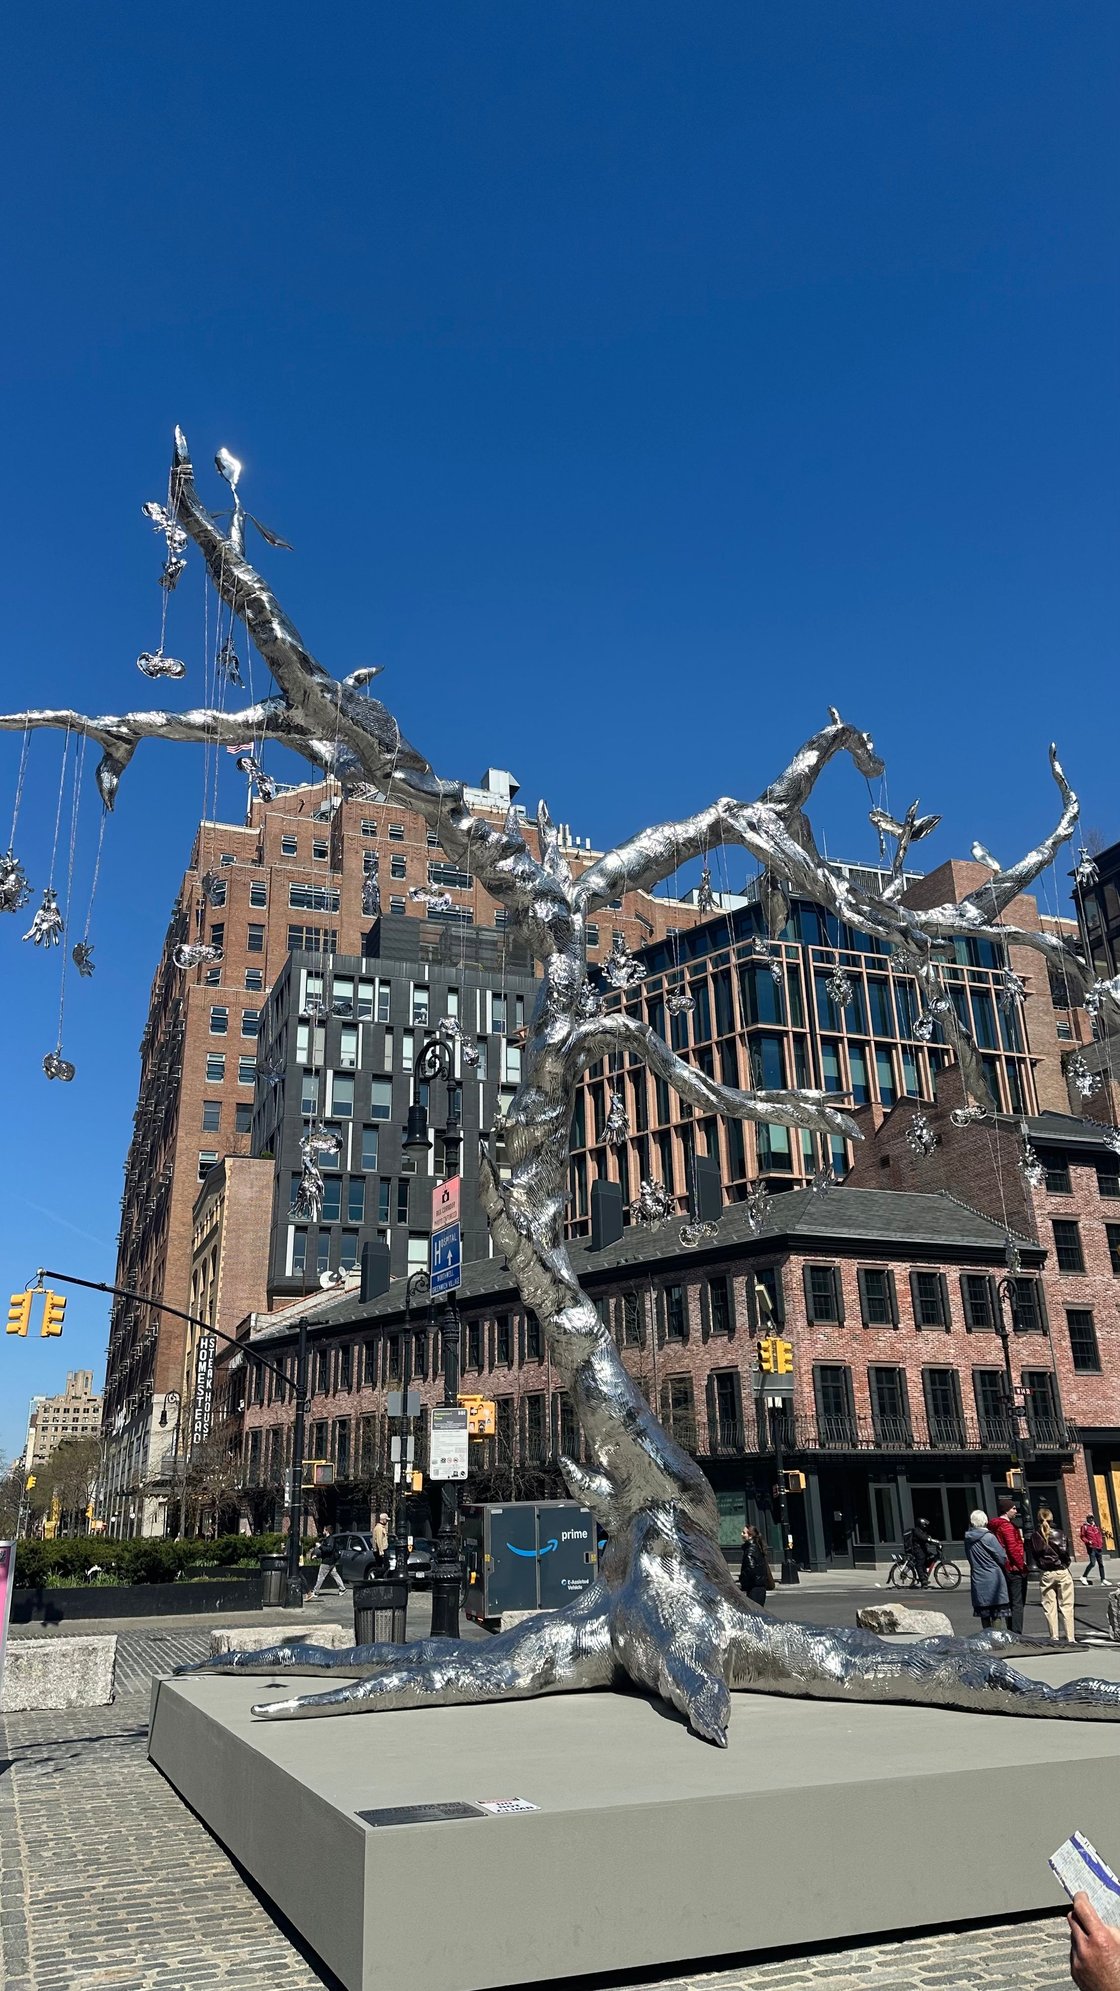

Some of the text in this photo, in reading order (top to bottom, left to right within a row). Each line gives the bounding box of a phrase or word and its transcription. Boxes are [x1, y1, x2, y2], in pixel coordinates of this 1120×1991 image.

[434, 1232, 457, 1267] HOSPITAL
[193, 1337, 208, 1444] HOMESTEAD
[202, 1337, 215, 1444] STEAK HOUSE
[561, 1529, 588, 1542] prime
